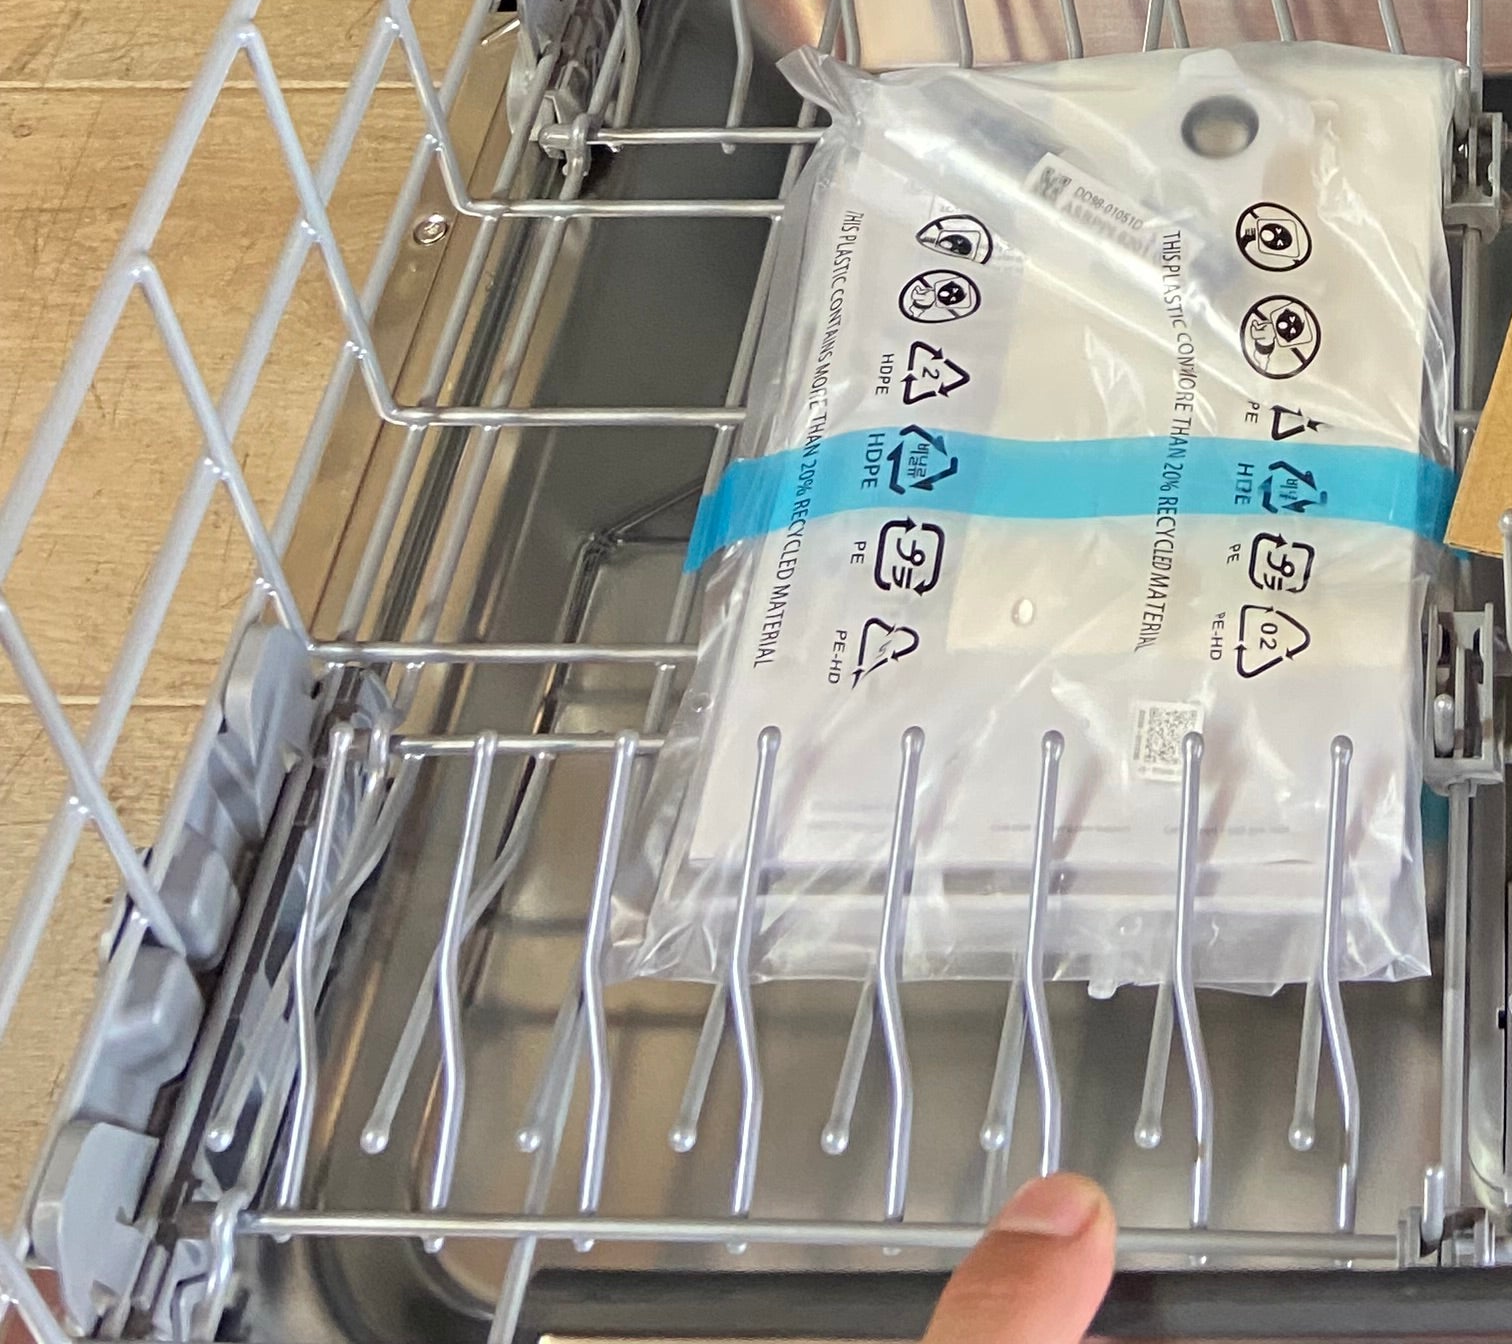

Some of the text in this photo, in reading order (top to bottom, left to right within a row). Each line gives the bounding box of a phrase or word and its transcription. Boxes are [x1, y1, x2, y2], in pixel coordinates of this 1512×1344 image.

[841, 210, 864, 232] THIS
[831, 234, 858, 289] PLASTIC
[1162, 230, 1181, 262] THIS
[1162, 265, 1187, 329] PLASTIC
[817, 288, 845, 363] CONTAINS
[875, 353, 895, 396] HDPE
[921, 366, 940, 380] 2
[802, 411, 827, 458] THAN
[1167, 417, 1192, 459] THAN
[798, 460, 819, 497] 20%
[860, 432, 886, 490] HDPE
[1159, 462, 1184, 492] 20%
[777, 497, 811, 581] RECYCLED
[850, 540, 867, 565] PE
[1151, 496, 1179, 571] RECYCLED
[1226, 543, 1241, 565] PE
[753, 583, 792, 669] MATERIAL
[1133, 572, 1171, 653] MATERIAL
[1210, 611, 1226, 661] PE-HD
[828, 629, 848, 685] PE-HD
[1259, 622, 1279, 651] 02
